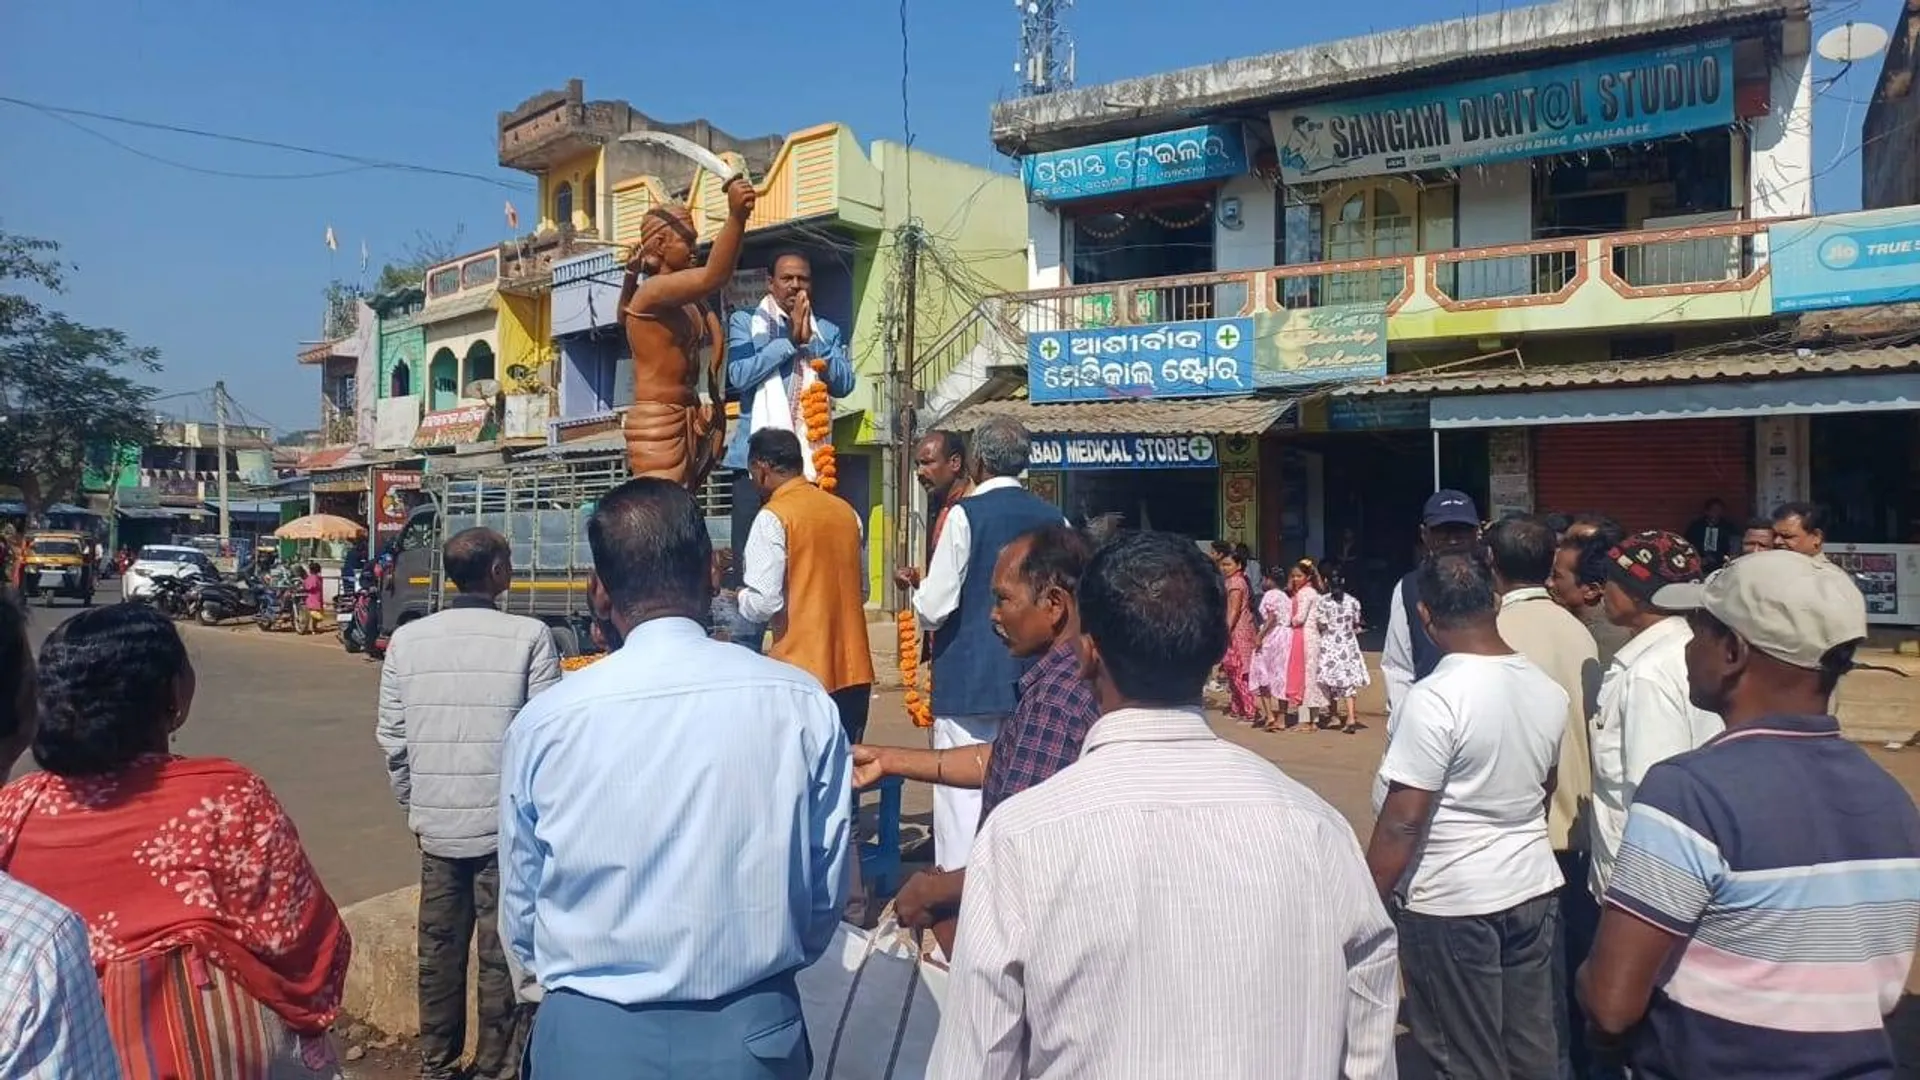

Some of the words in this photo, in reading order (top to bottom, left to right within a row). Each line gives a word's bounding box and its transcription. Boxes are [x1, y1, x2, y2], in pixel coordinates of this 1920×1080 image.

[1329, 101, 1450, 159] SANGAM
[1459, 79, 1589, 143] DIGIT@L
[1598, 55, 1720, 122] STUDIO
[1573, 124, 1649, 146] AVAILABLE
[1036, 154, 1106, 183] ପ୍ରଶାନ୍ତ
[1866, 239, 1913, 256] TRUE
[1071, 326, 1201, 355] ଆଶୀର୍ବାଦ
[1029, 440, 1062, 464] BAD
[1066, 439, 1132, 463] MEDICAL
[1135, 437, 1189, 462] STORE
